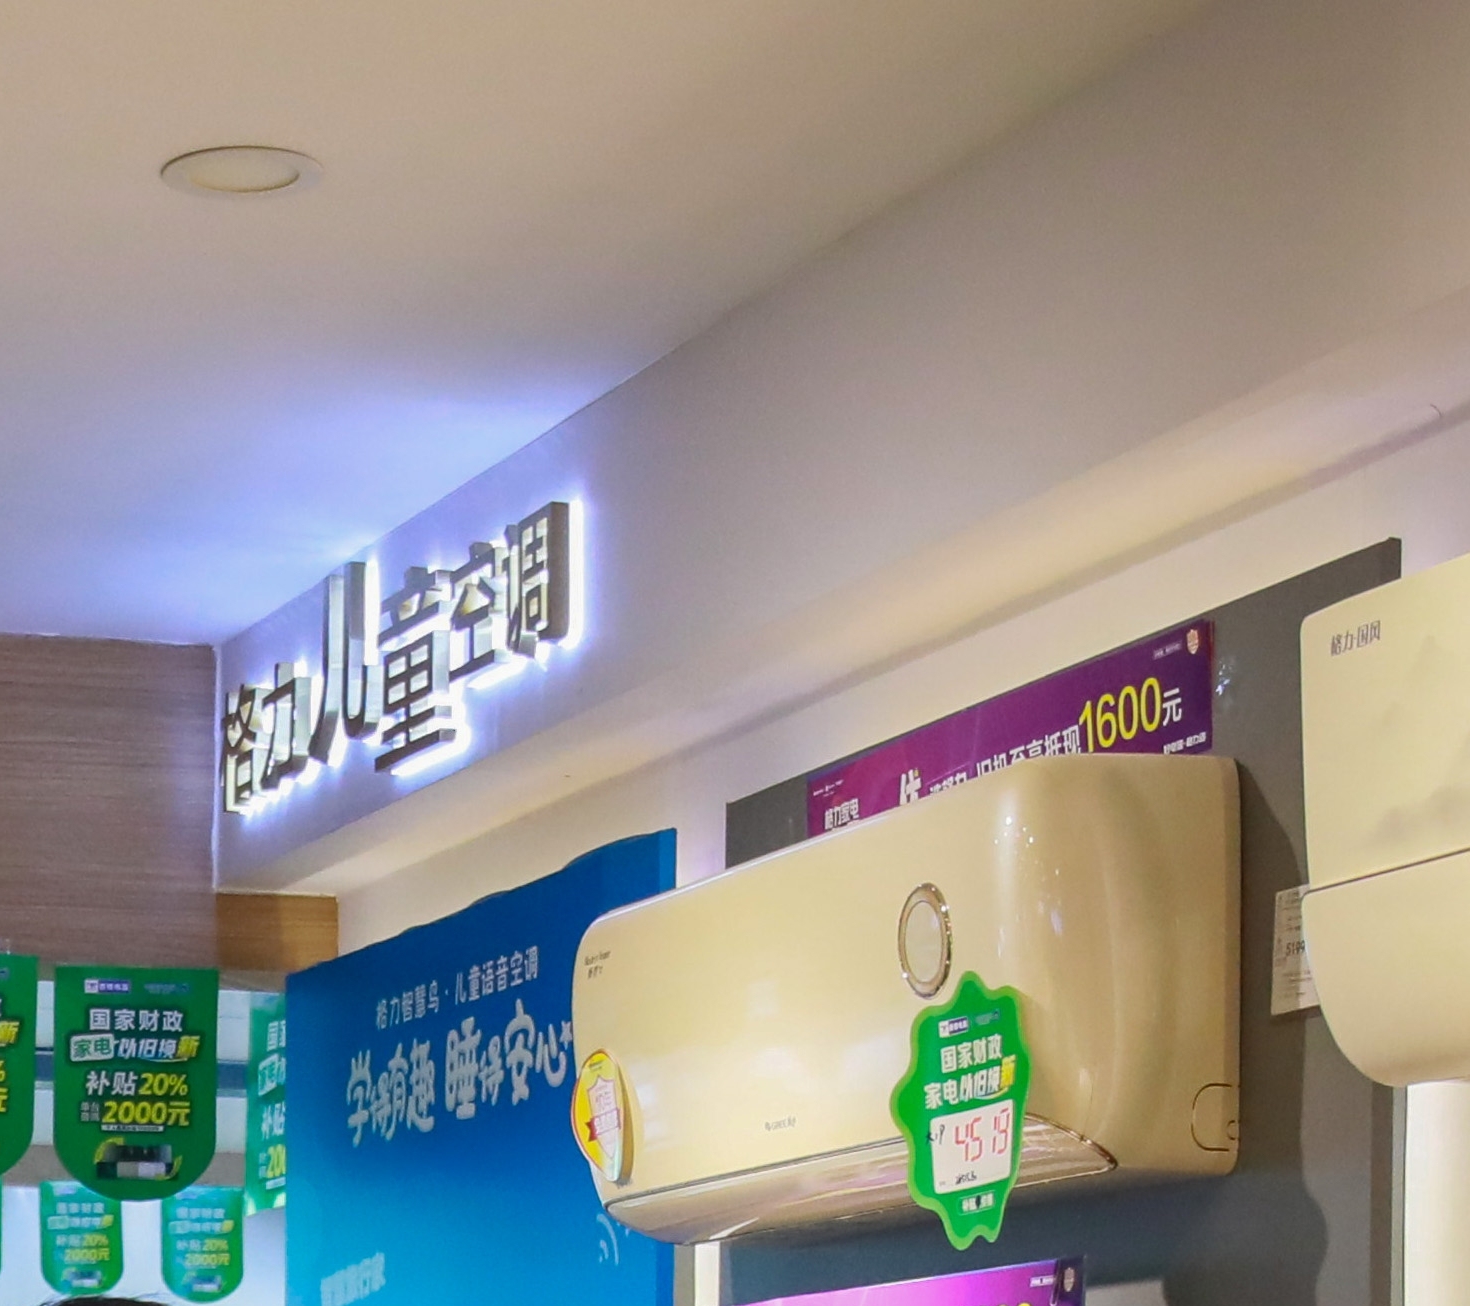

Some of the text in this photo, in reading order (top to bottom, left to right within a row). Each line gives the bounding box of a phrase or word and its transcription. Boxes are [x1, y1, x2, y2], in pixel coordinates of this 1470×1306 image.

[222, 501, 568, 812] 格力儿童空调
[90, 1008, 184, 1032] 国家财政
[346, 999, 567, 1147] 学得有趣 睡得安心
[940, 1035, 1002, 1073] 国家财政
[86, 1070, 189, 1096] 补贴20%
[924, 1056, 1016, 1110] 家电以旧换新
[102, 1101, 191, 1126] 2000元
[955, 1108, 1010, 1162] 4519
